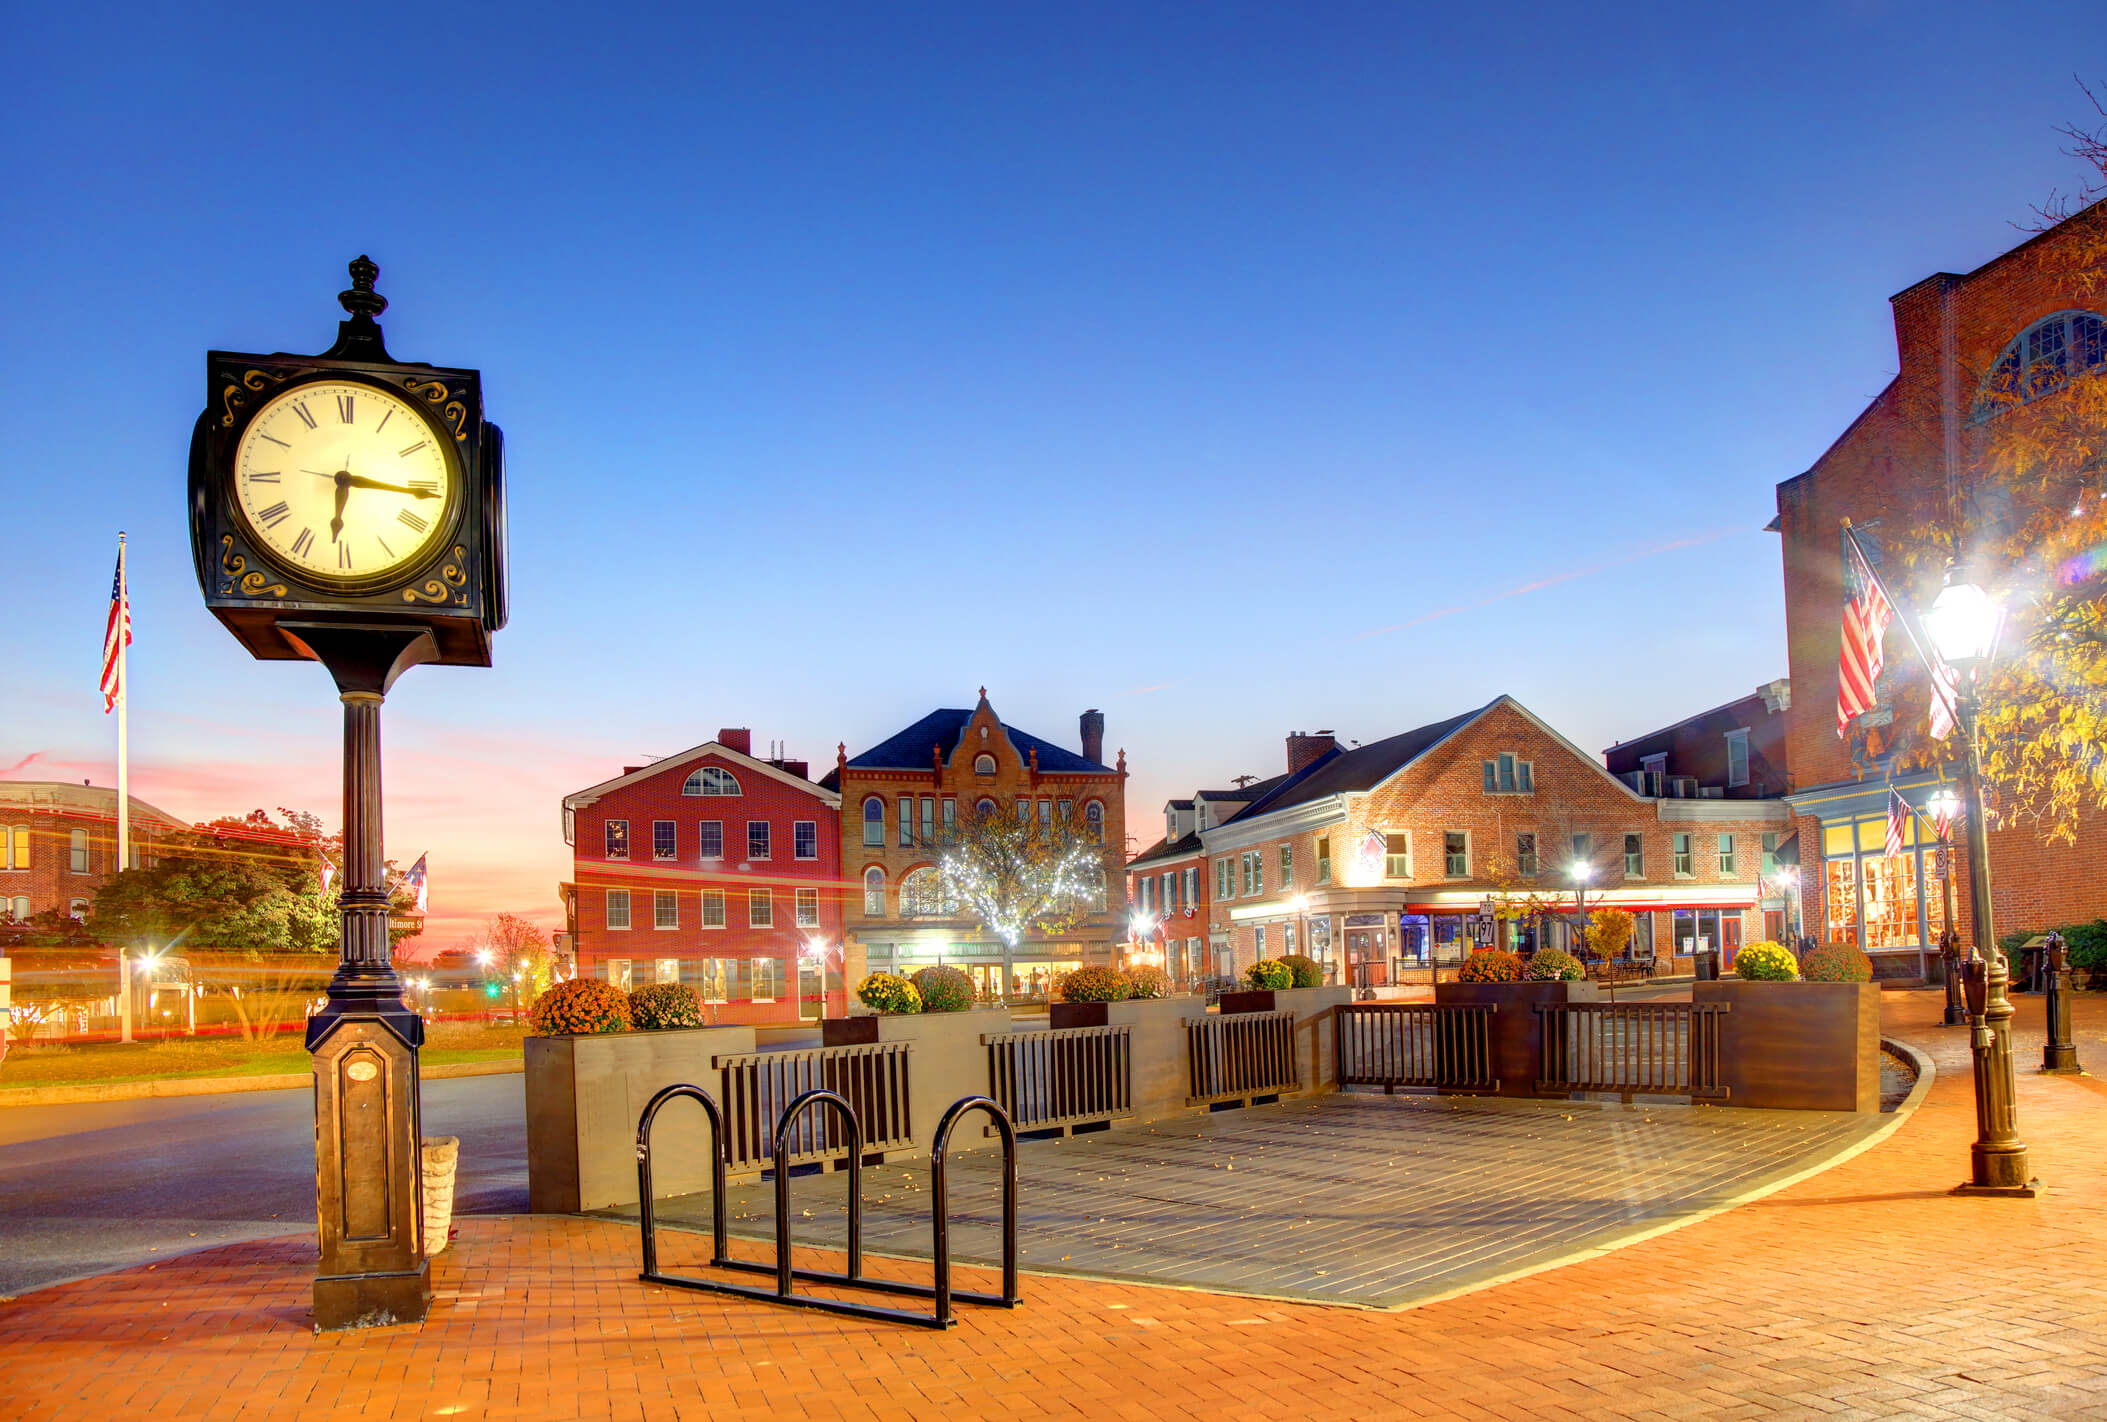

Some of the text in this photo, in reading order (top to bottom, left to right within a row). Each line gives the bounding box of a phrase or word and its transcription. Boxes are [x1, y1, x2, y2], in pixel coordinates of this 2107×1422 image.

[336, 395, 354, 424] XII
[398, 441, 427, 458] II
[257, 501, 293, 529] VIII
[1482, 903, 1492, 912] TO
[389, 917, 415, 928] ltimore
[1481, 921, 1492, 936] 97
